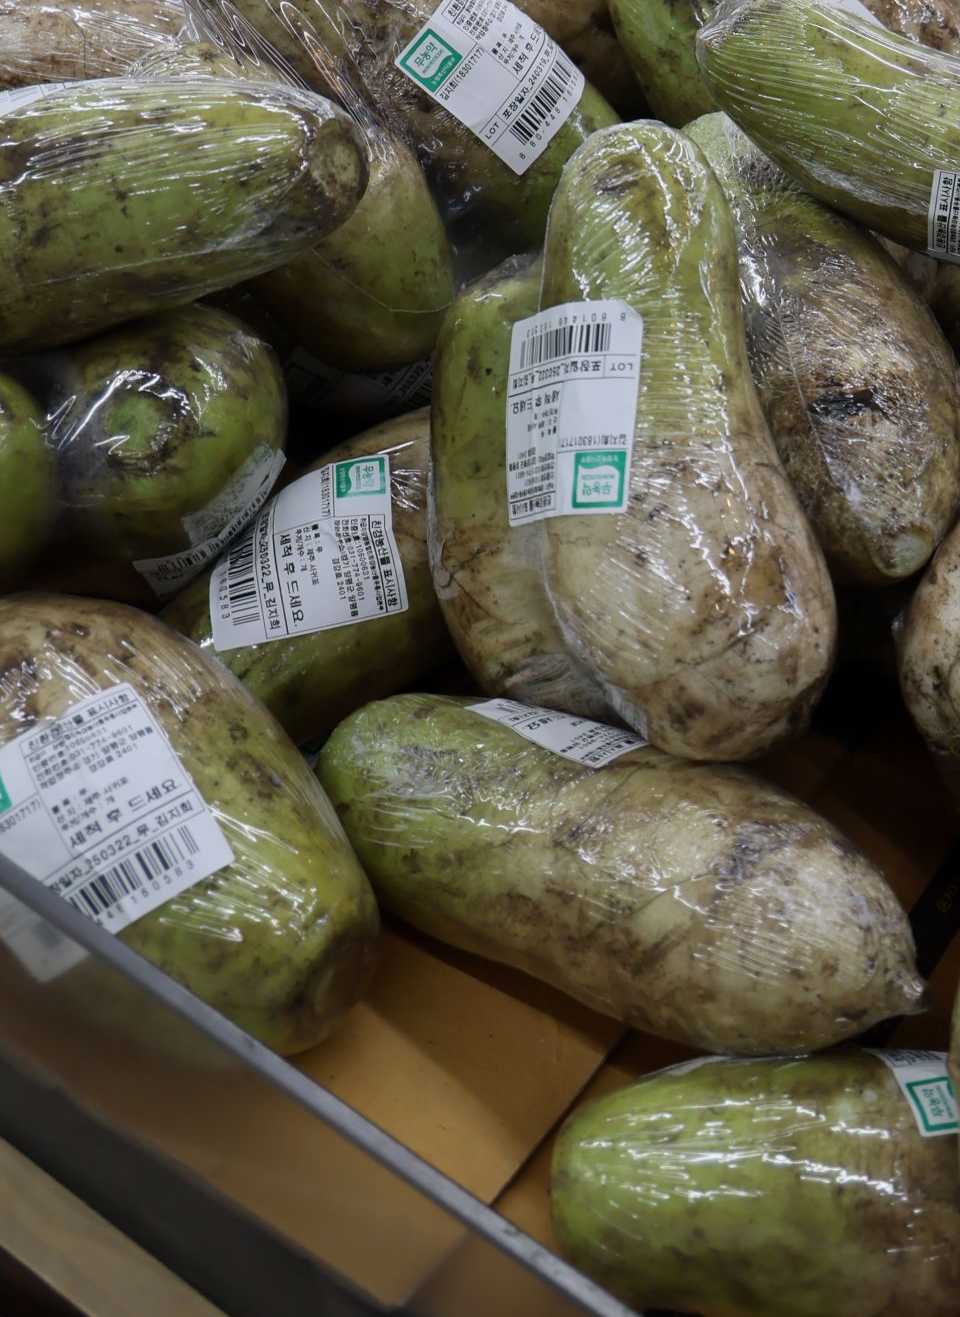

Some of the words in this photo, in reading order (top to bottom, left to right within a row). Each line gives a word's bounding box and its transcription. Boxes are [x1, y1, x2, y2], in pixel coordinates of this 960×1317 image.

[414, 41, 438, 67] 무농약
[511, 52, 528, 74] 세척
[524, 41, 534, 53] 후
[485, 121, 500, 139] LOT
[939, 177, 951, 210] 표시사항
[609, 363, 632, 371] LOT
[582, 482, 610, 496] 무농약
[280, 533, 292, 557] 세척
[284, 561, 295, 575] 후
[371, 519, 390, 565] 친경농산물
[383, 568, 397, 606] 표시사항
[337, 581, 345, 600] 2401
[287, 580, 304, 626] 드세요.
[87, 692, 128, 716] 표시사항
[67, 820, 102, 848] 세척
[106, 807, 123, 823] 후
[127, 775, 181, 812] 드세요.
